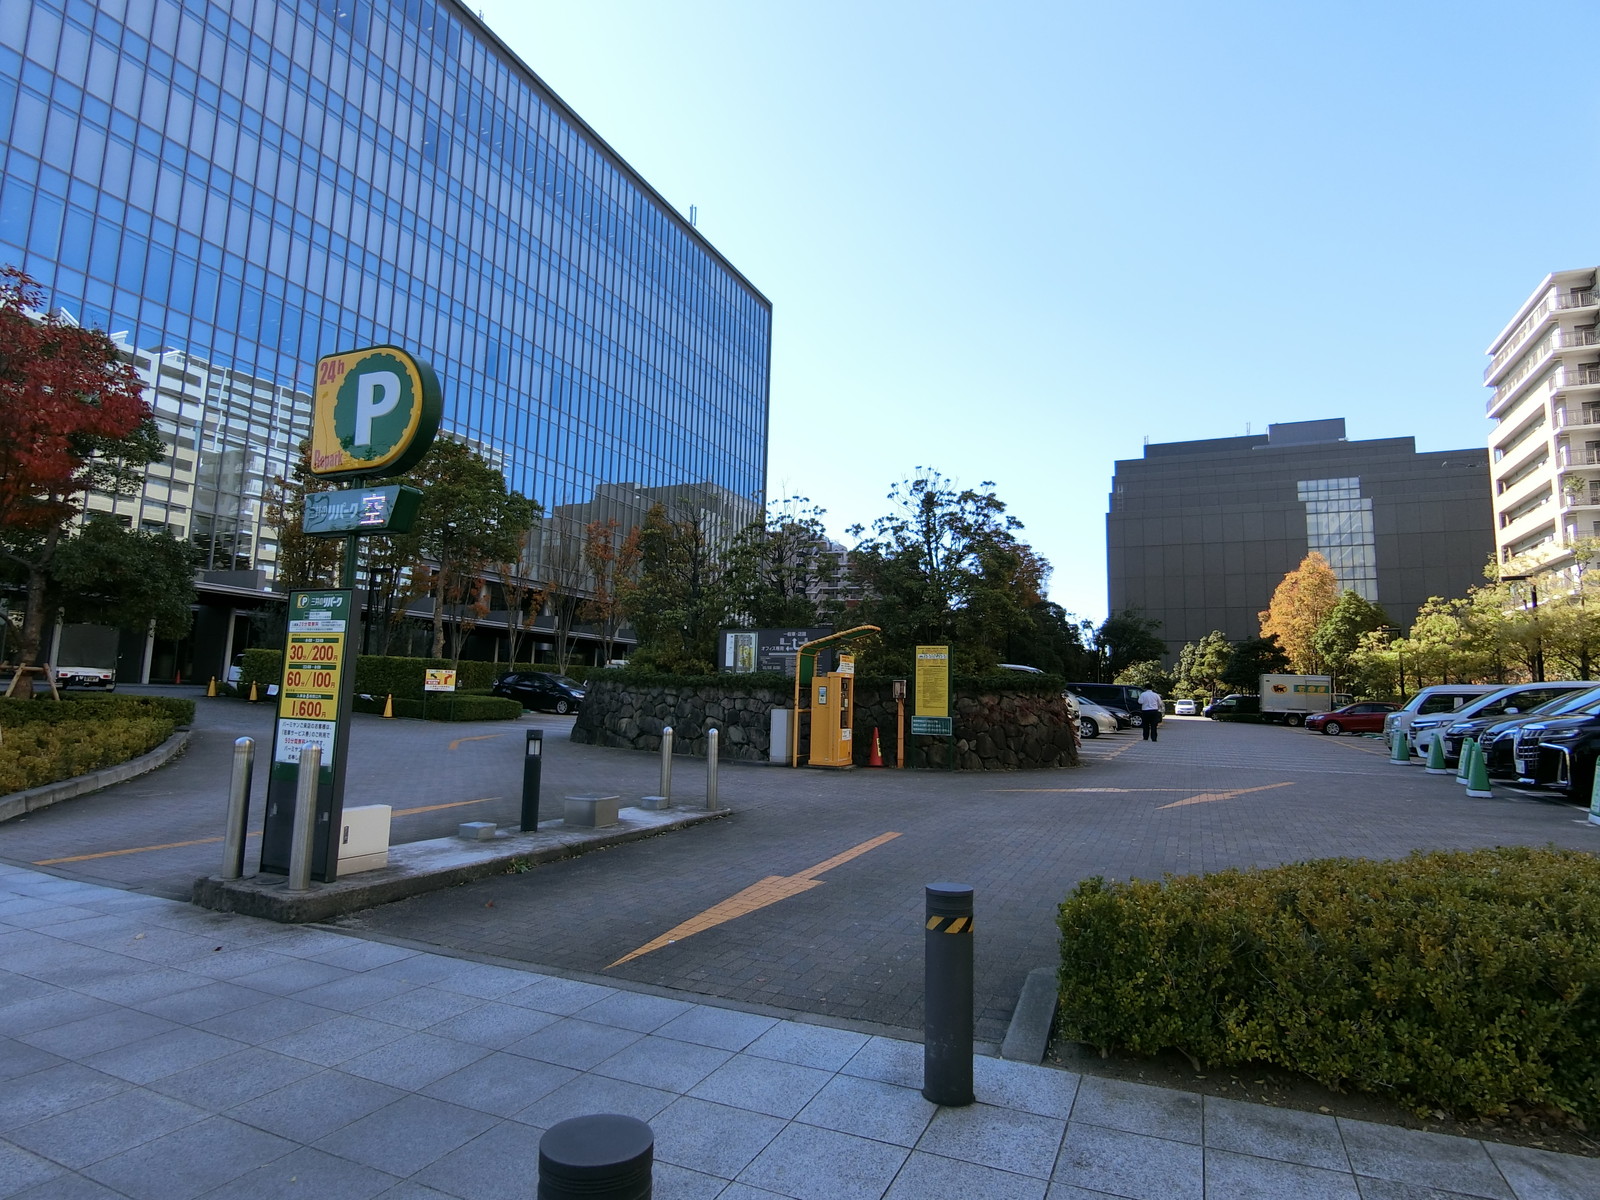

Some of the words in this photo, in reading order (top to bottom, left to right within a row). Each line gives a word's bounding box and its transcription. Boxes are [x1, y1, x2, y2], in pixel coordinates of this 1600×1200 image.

[320, 360, 344, 385] 24h
[354, 371, 401, 446] P
[314, 449, 343, 470] Repark
[360, 494, 386, 524] 空
